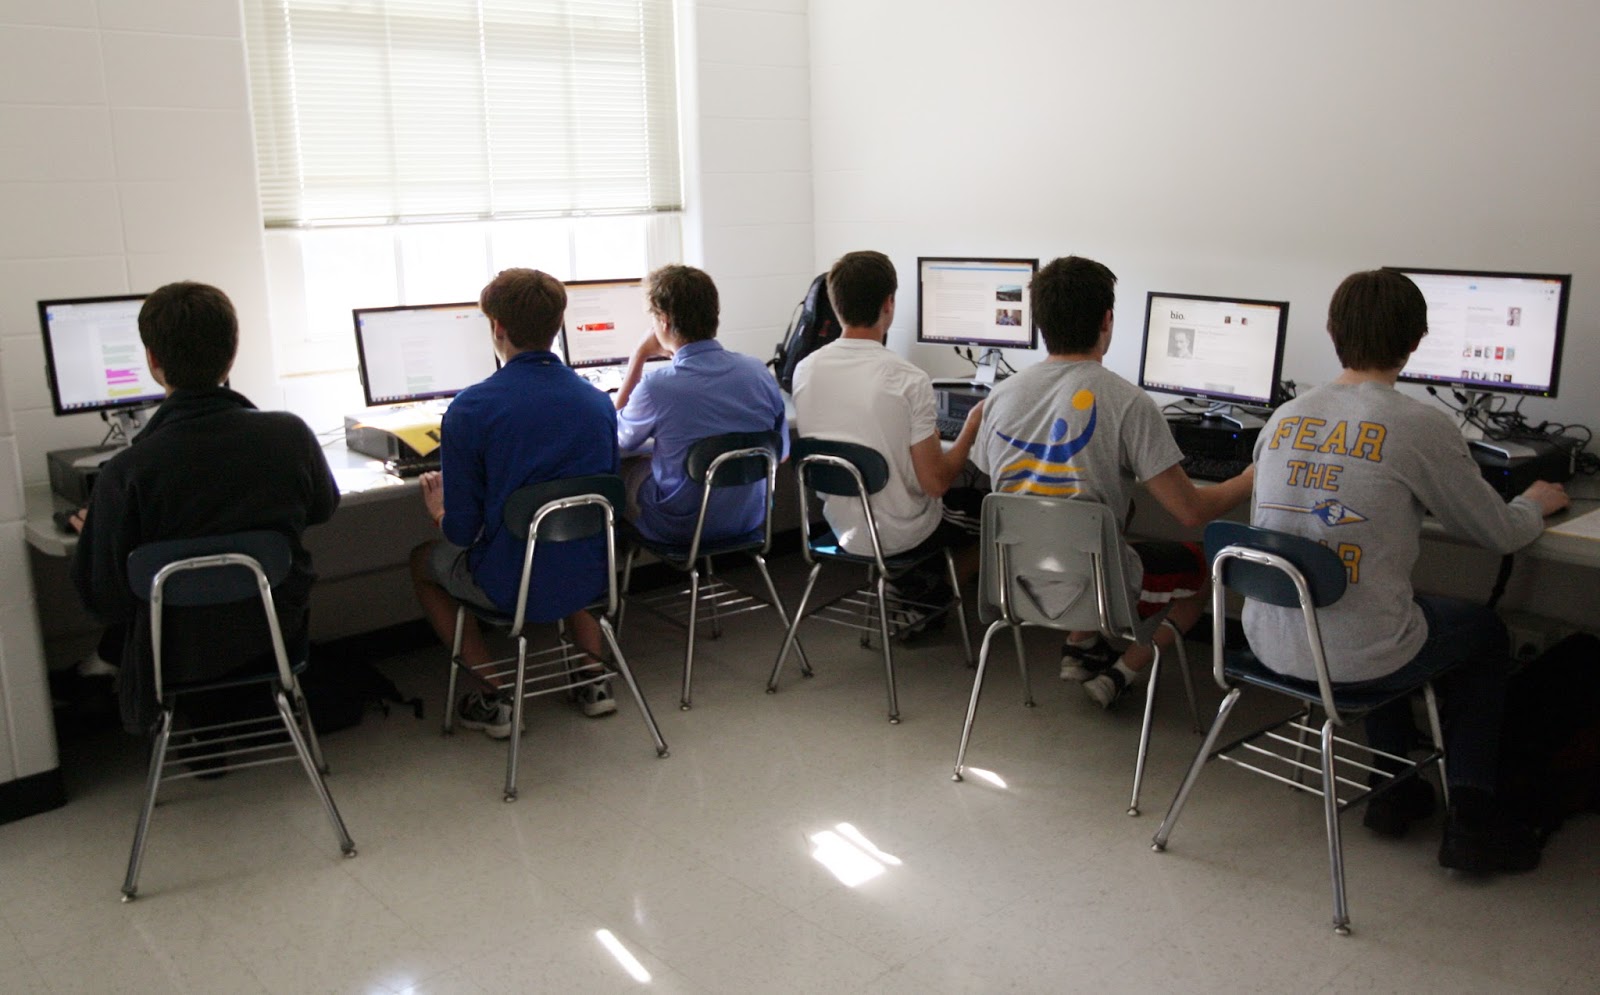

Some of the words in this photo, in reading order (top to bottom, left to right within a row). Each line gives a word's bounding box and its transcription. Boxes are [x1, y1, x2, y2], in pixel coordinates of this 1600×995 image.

[1170, 310, 1186, 321] bio.
[1269, 416, 1387, 462] FEAR
[1287, 460, 1343, 491] THE
